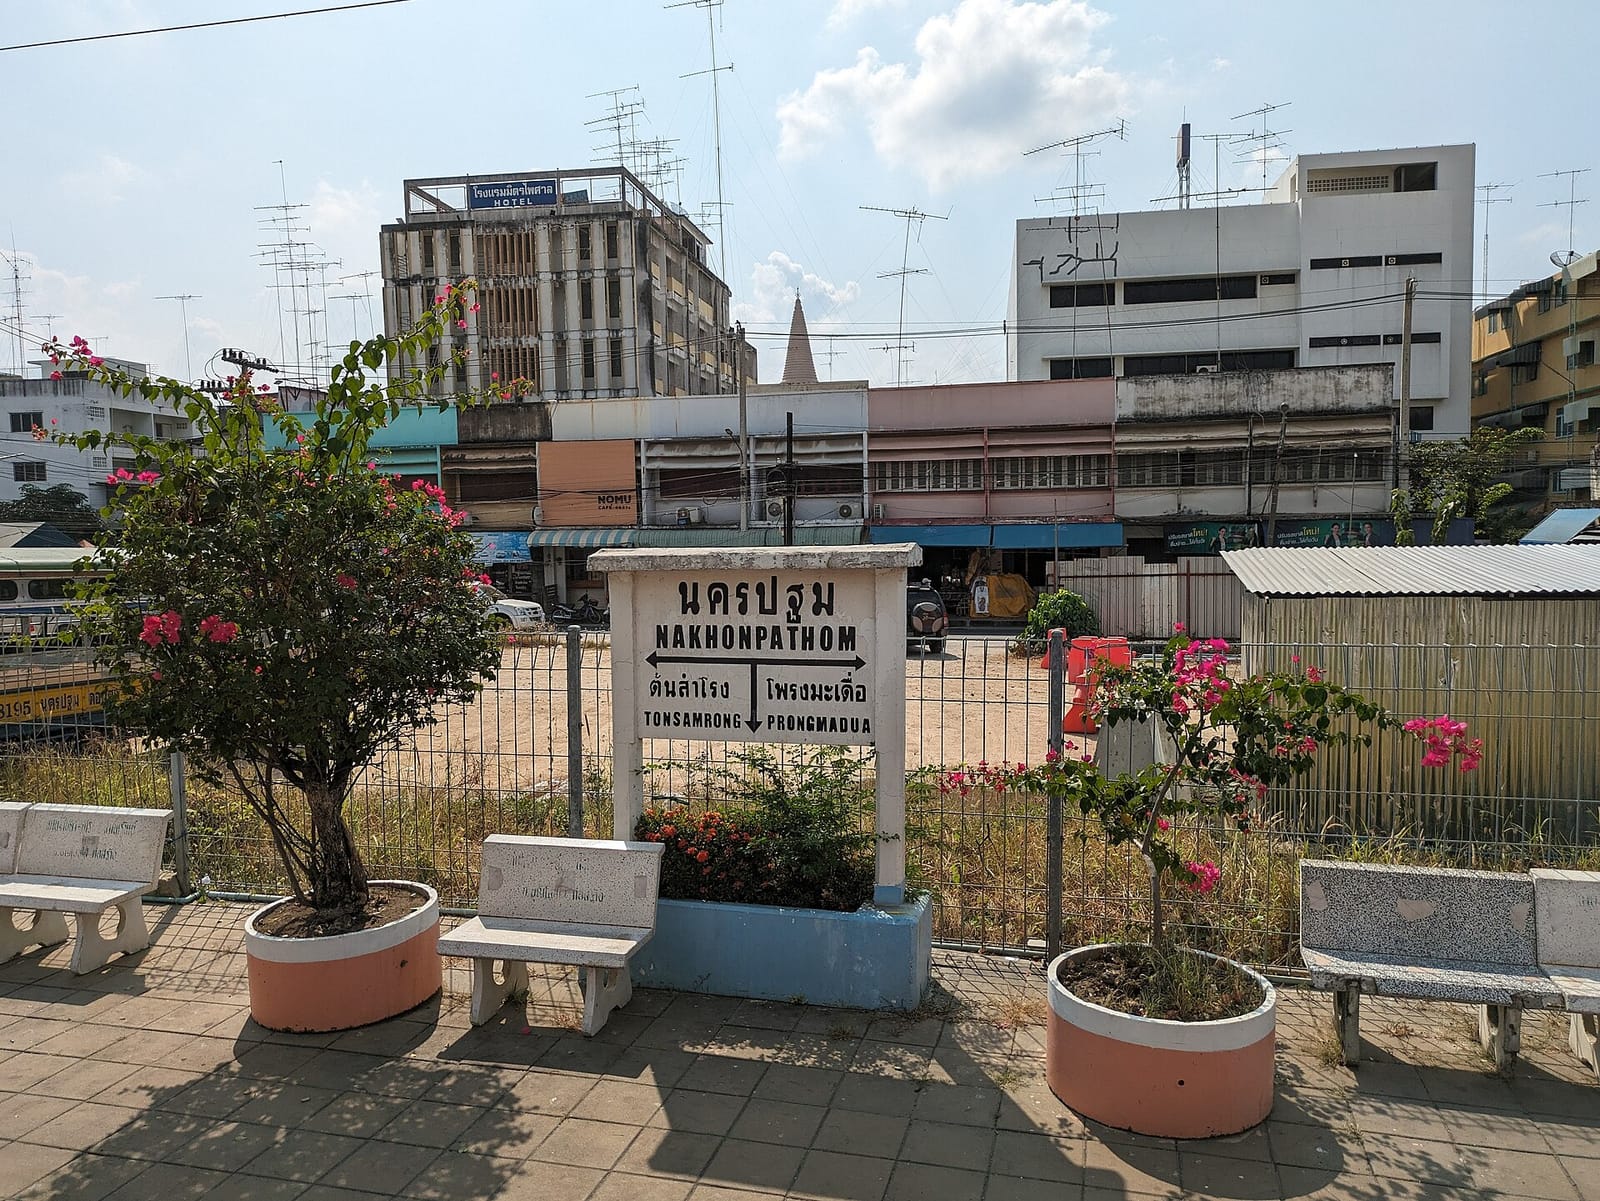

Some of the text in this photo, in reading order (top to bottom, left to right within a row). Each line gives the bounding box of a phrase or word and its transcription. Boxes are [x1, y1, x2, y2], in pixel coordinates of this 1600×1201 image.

[473, 183, 553, 199] โรงแรมมิตรไพศาล
[494, 198, 533, 207] HOTEL
[598, 495, 632, 504] NOMU
[678, 576, 835, 623] นครปฐม
[656, 624, 857, 652] NAKHONPATHOM
[649, 673, 730, 699] ต้นสำโรง
[766, 672, 867, 703] โพรงมะเดื่อ
[644, 711, 741, 729] TONSAMRONG
[767, 714, 871, 734] PRONGMADUA
